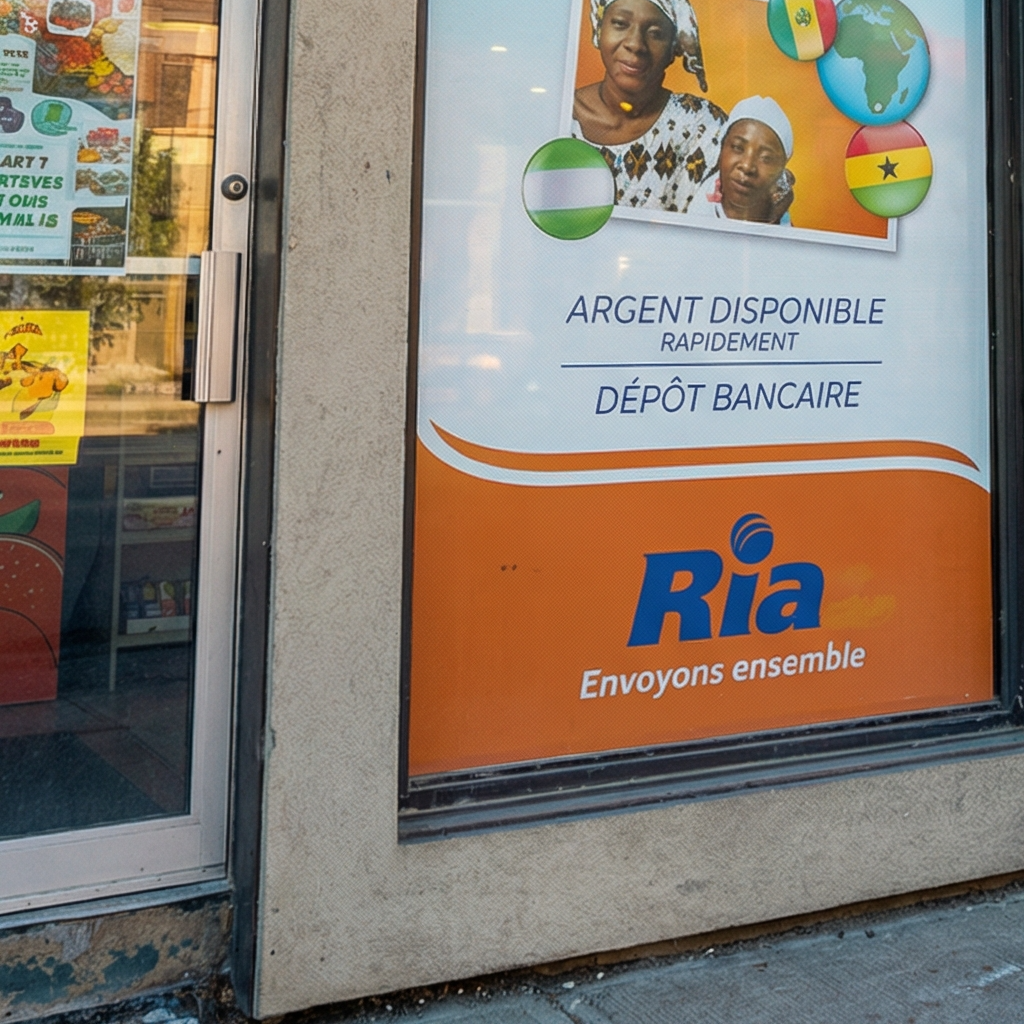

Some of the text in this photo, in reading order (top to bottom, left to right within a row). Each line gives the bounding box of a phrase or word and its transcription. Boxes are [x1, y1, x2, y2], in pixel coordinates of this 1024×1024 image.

[565, 294, 887, 325] ARGENT DISPONIBLE
[660, 331, 800, 353] RAPIDEMENT
[595, 376, 863, 415] DÉPÔT BANCAIRE
[626, 512, 825, 648] Ria
[579, 640, 867, 700] Envoyons ensemble
